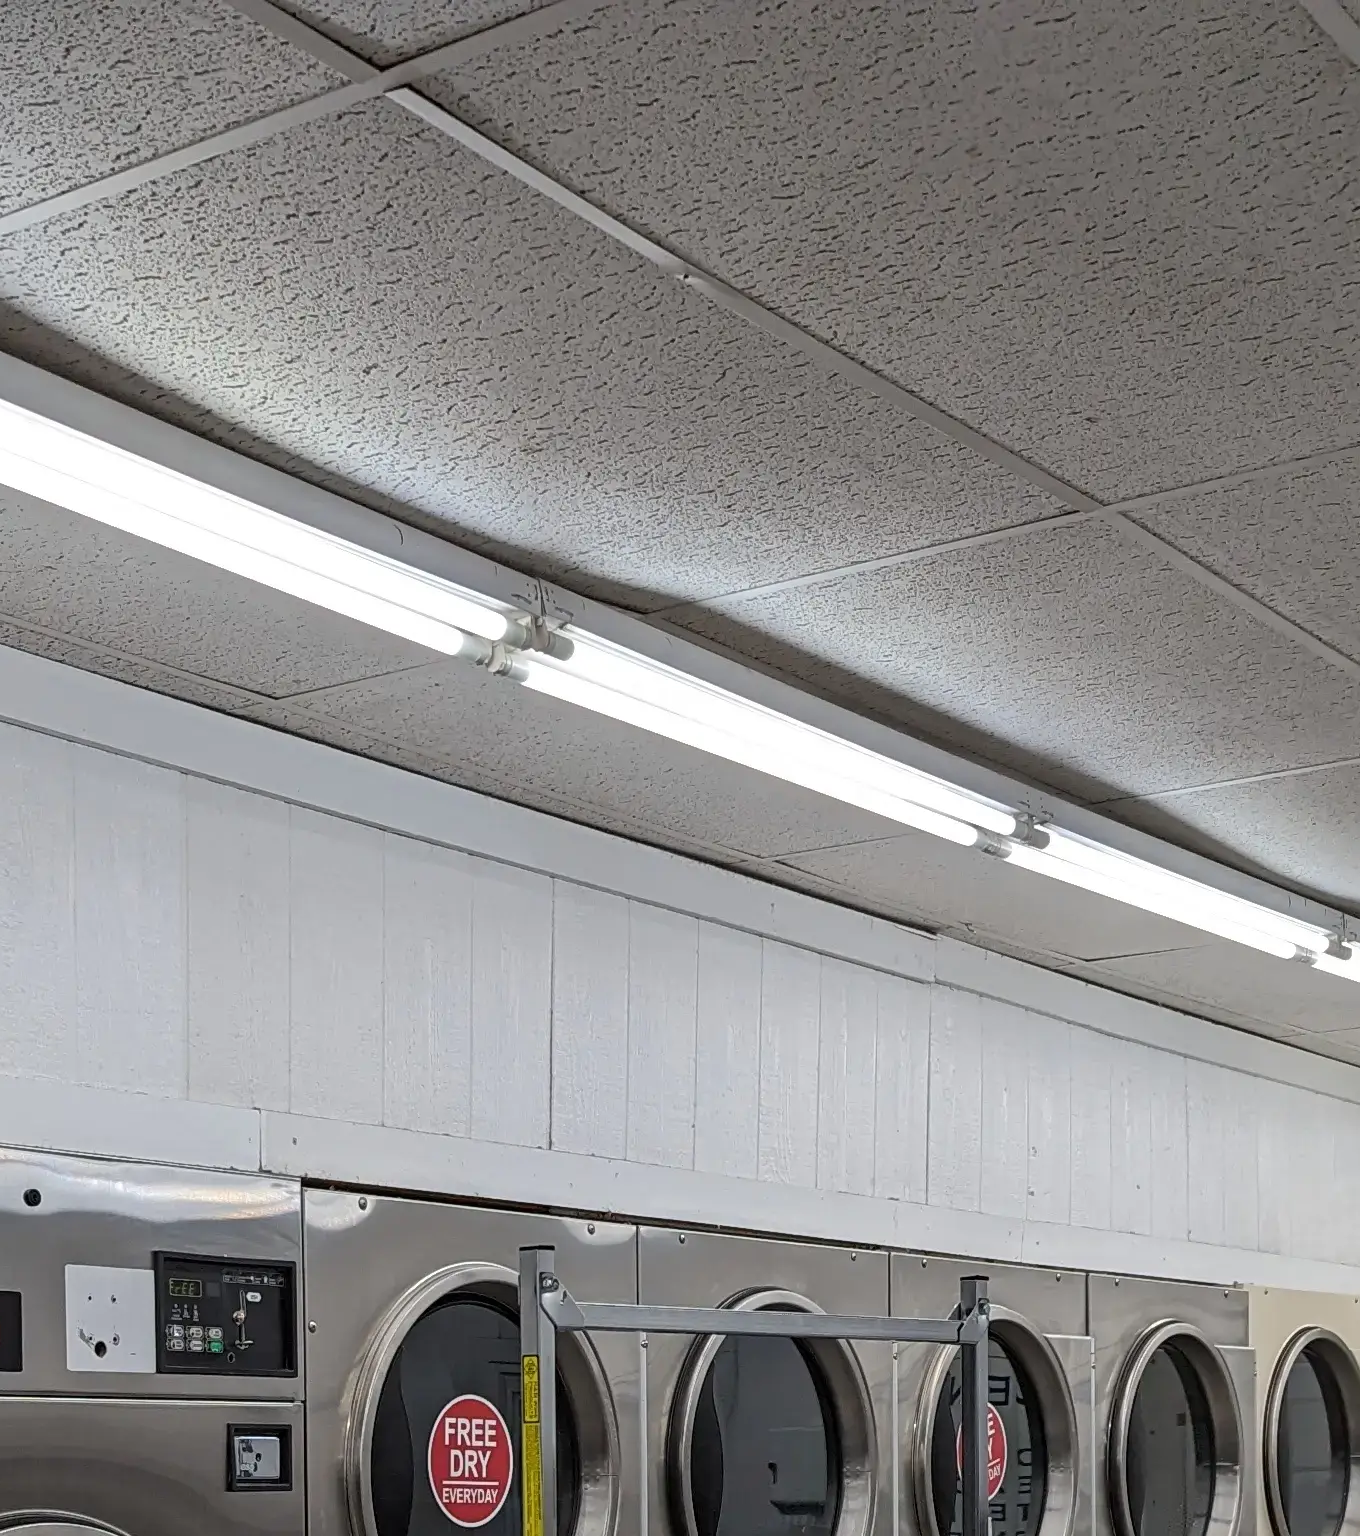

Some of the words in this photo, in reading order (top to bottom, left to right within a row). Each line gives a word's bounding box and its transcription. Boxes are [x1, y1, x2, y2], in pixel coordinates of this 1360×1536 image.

[444, 1417, 497, 1447] FREE
[450, 1449, 491, 1478] DRY
[442, 1487, 498, 1503] EVERYDAY
